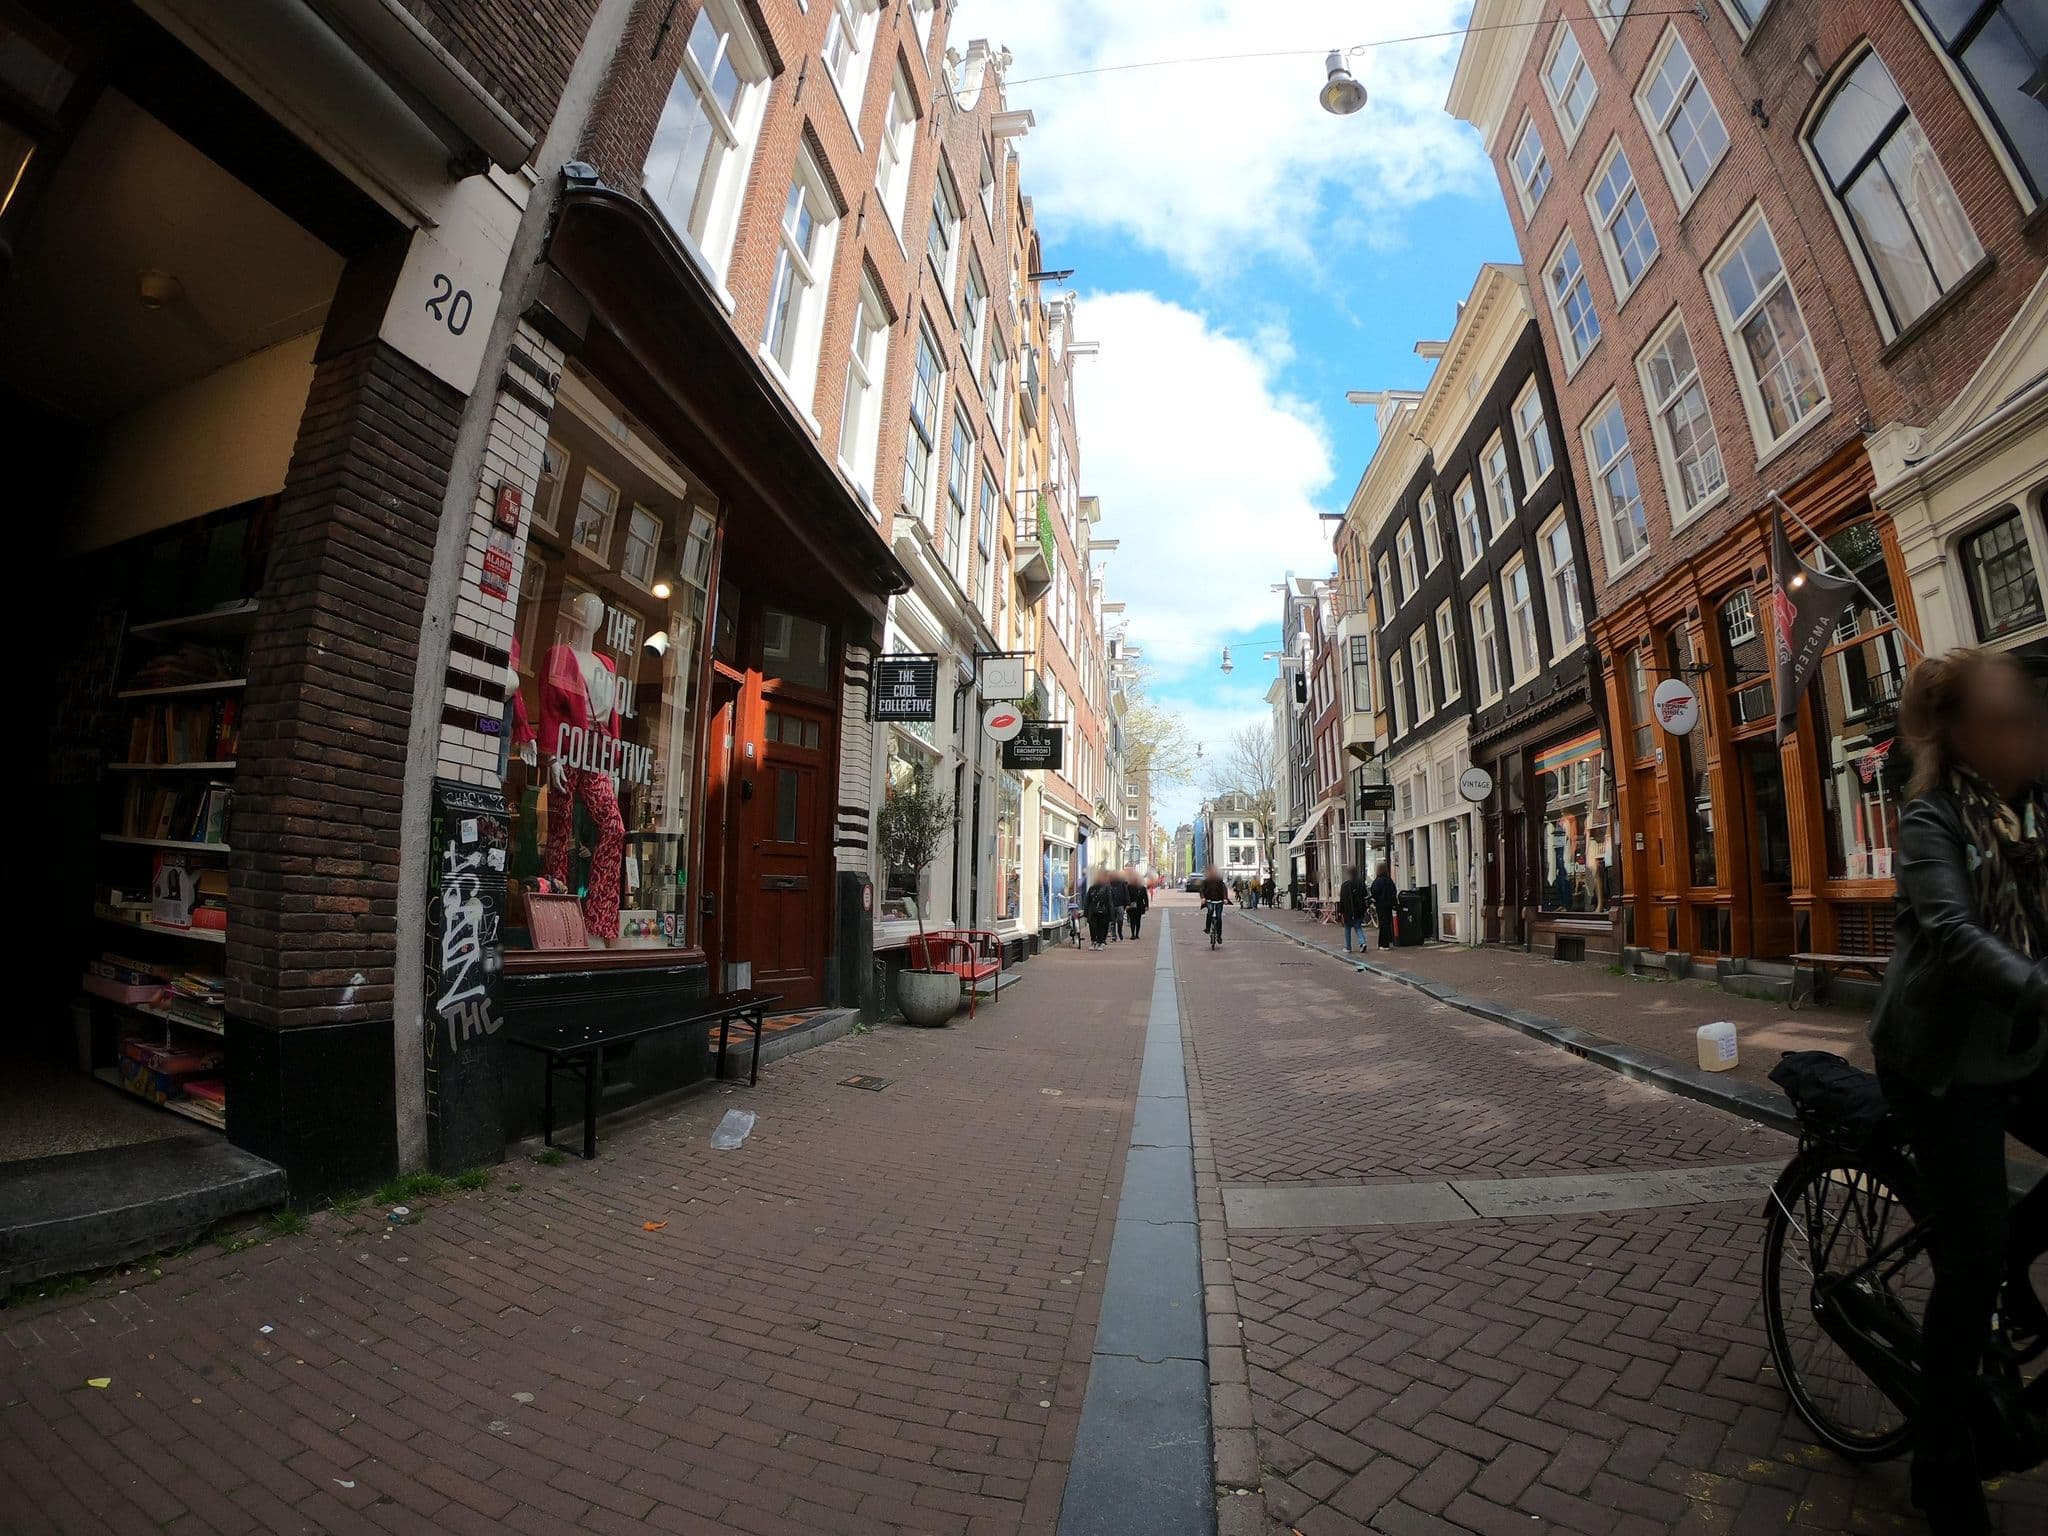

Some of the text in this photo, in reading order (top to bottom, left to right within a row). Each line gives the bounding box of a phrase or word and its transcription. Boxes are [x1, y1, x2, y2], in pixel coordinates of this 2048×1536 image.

[425, 274, 473, 336] 20
[485, 552, 512, 571] ALARM
[606, 605, 637, 657] THE
[898, 670, 915, 683] THE
[893, 685, 918, 698] COOL
[879, 699, 932, 712] COLLECTIVE
[556, 722, 654, 786] COLLECTIVE
[1461, 780, 1491, 789] VINTAGE
[441, 997, 504, 1054] THC
